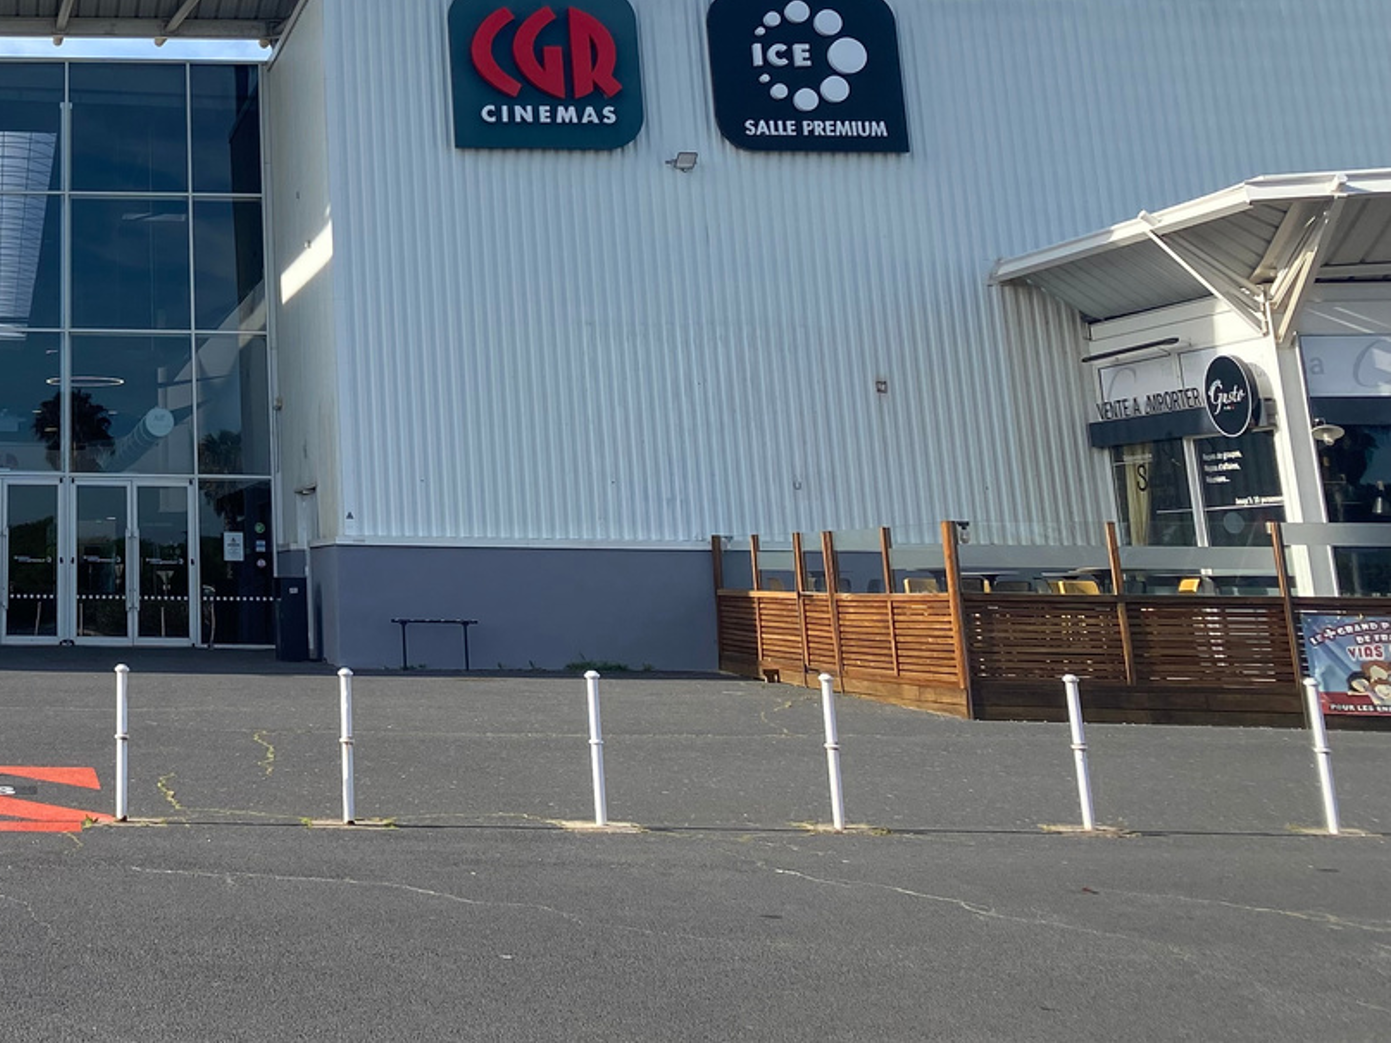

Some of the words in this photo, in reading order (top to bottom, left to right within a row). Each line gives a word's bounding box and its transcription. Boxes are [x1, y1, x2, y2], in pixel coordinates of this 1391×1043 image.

[471, 6, 623, 99] CGR
[751, 43, 813, 67] ICE
[480, 105, 618, 124] CINEMAS
[744, 119, 797, 136] SALLE
[802, 120, 889, 138] PREMIUM
[1096, 398, 1130, 420] VENTE
[1132, 396, 1142, 415] A
[1336, 621, 1379, 636] GRAND
[1347, 644, 1384, 660] VIAS
